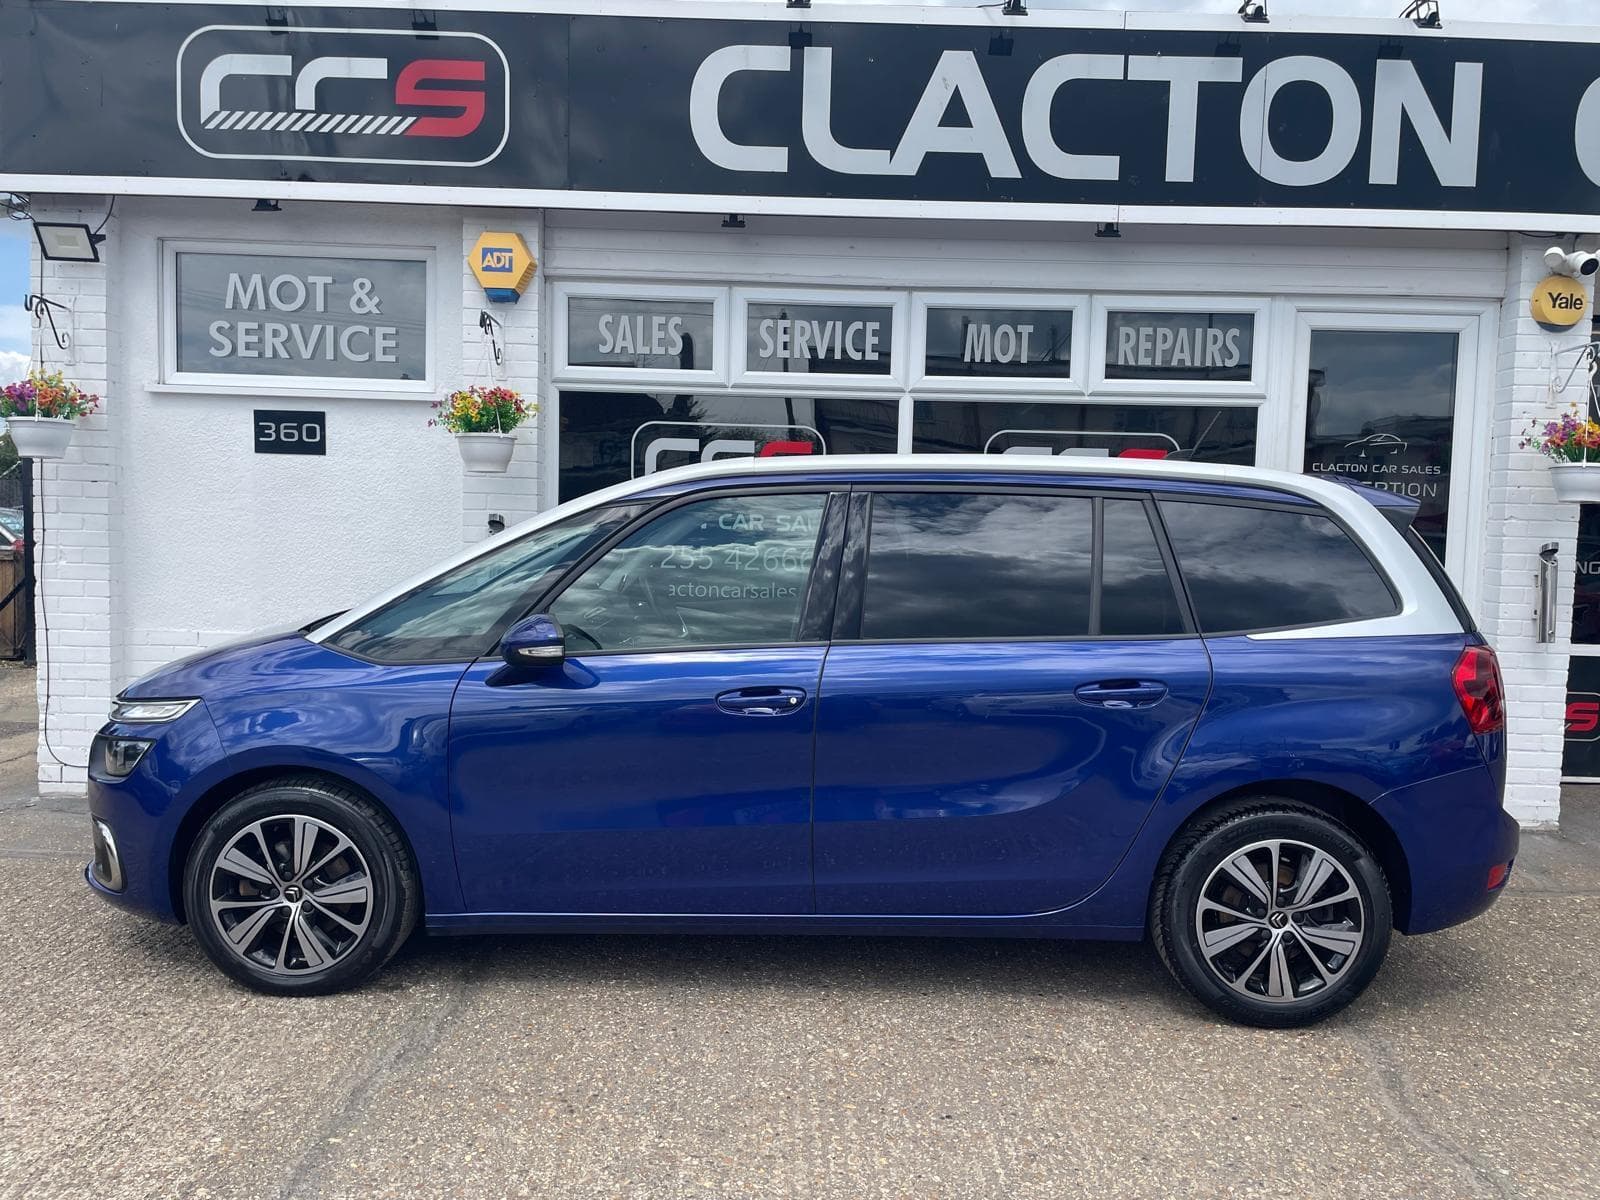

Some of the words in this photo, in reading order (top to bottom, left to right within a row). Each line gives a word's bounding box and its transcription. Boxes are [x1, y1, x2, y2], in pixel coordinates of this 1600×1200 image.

[689, 44, 1483, 188] CLACTON
[481, 252, 513, 269] ADT
[225, 273, 333, 314] MOT
[350, 277, 382, 315] &
[1547, 291, 1584, 311] Yale
[208, 320, 399, 363] SERVICE
[598, 313, 684, 356] SALES
[758, 318, 881, 361] SERVICE
[963, 323, 1034, 364] MOT
[1117, 326, 1241, 368] REPAIRS
[258, 421, 321, 443] 360
[1312, 462, 1368, 473] CLACTON
[1372, 464, 1397, 474] CAR
[1401, 465, 1441, 475] SALES
[718, 513, 765, 531] CAR
